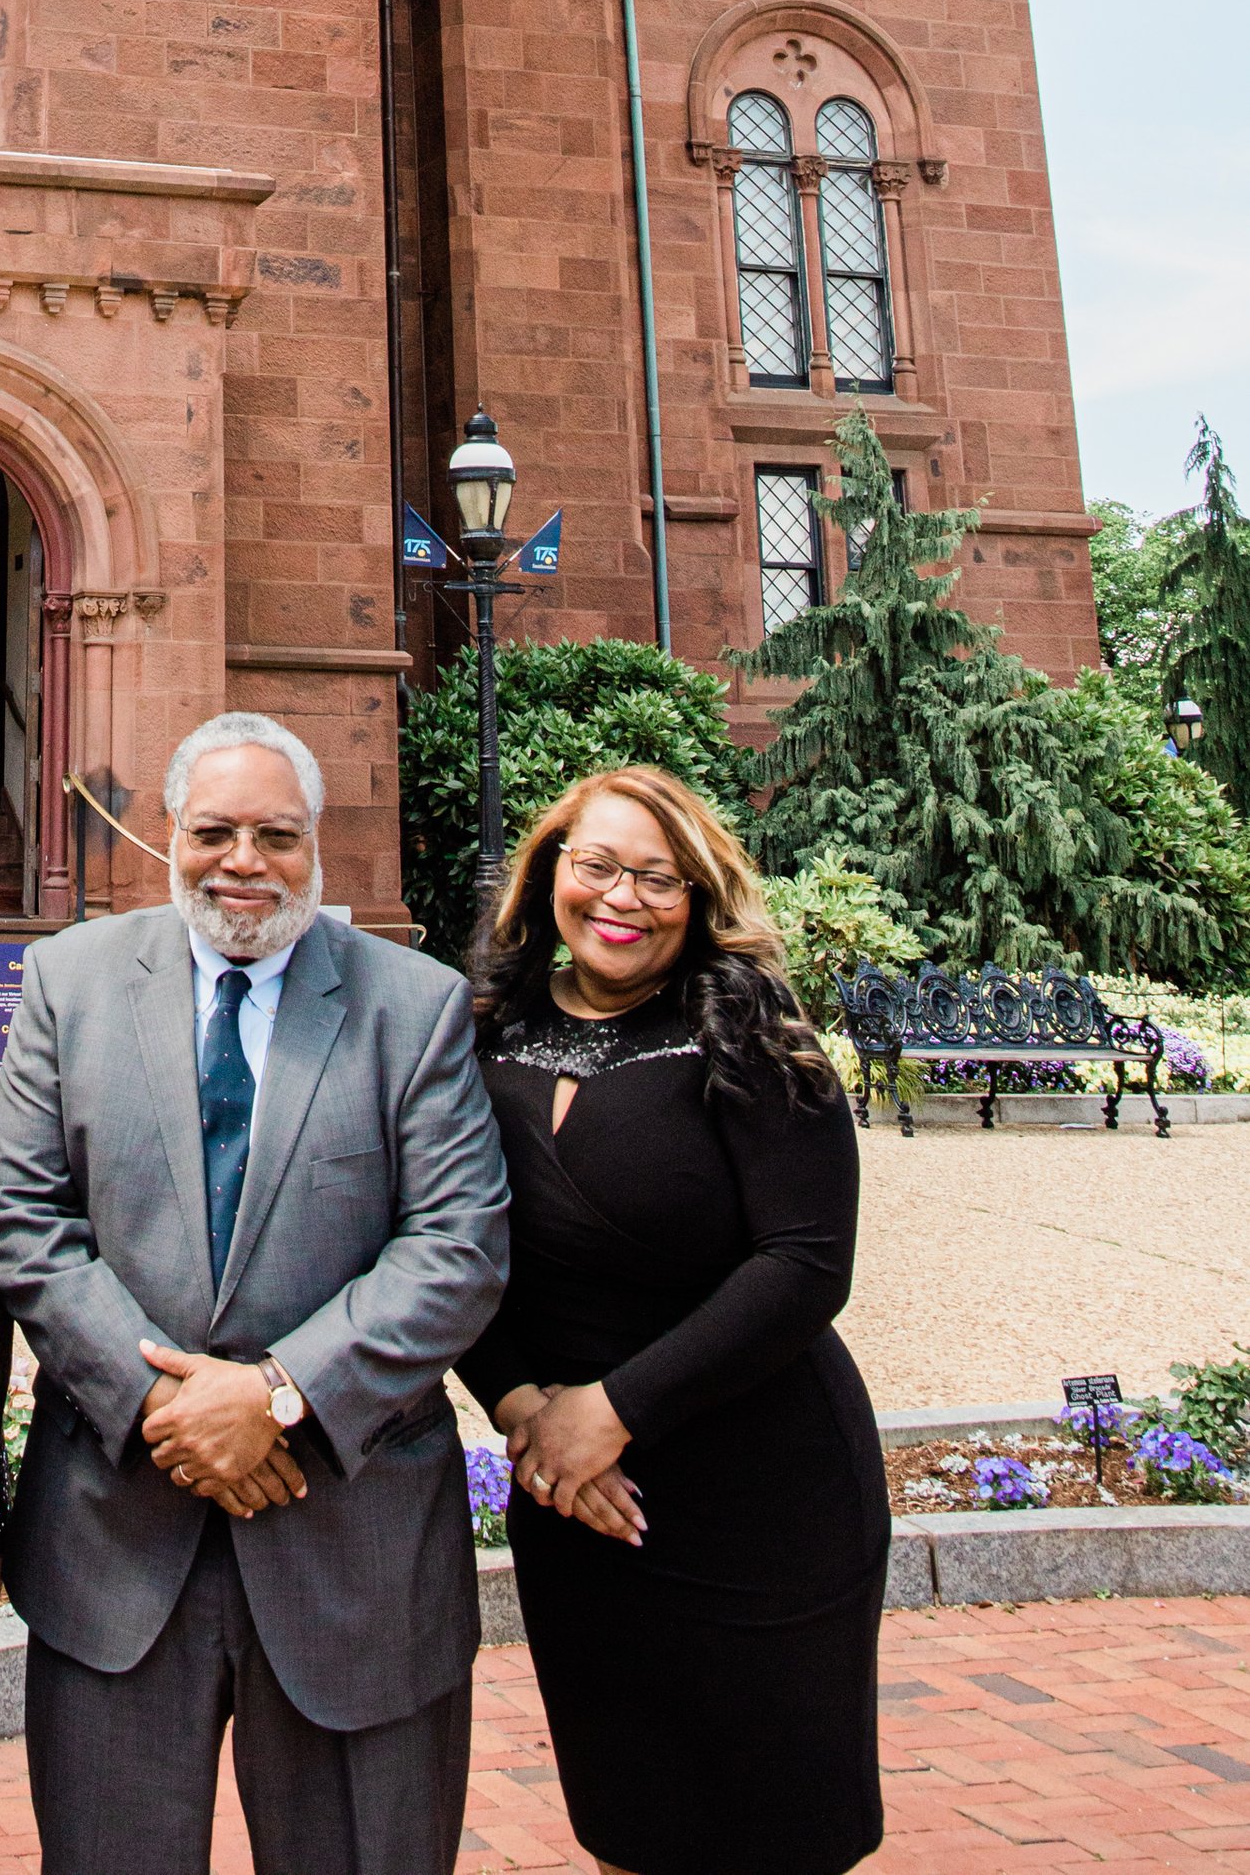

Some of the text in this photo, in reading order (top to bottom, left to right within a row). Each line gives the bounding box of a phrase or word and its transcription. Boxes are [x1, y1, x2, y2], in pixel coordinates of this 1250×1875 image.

[404, 538, 431, 555] 175
[534, 546, 558, 562] 175
[1071, 1392, 1093, 1401] Ghost
[1096, 1390, 1117, 1398] Plant
